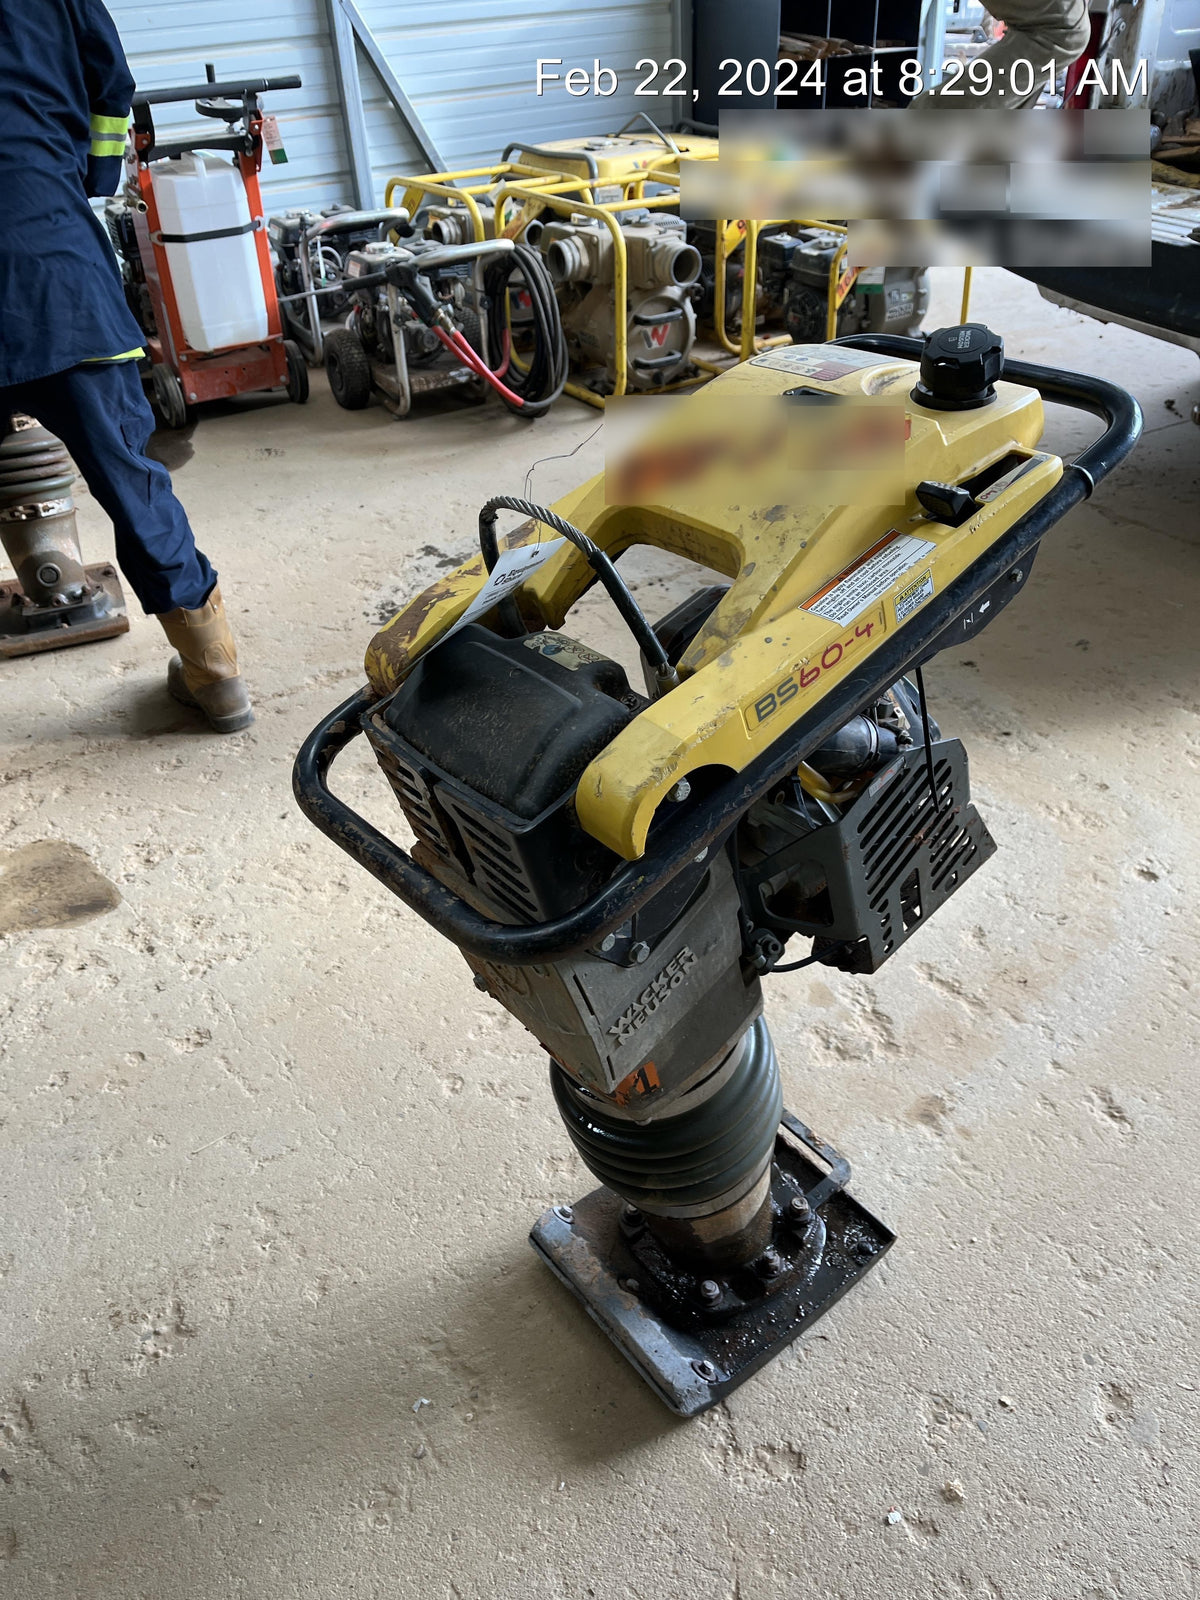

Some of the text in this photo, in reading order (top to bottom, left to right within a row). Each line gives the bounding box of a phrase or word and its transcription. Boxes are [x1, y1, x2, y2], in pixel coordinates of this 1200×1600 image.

[811, 596, 828, 610] Gasoline
[826, 594, 840, 605] engine
[869, 560, 882, 570] before
[833, 598, 847, 609] engine
[837, 611, 848, 619] Read
[847, 598, 864, 611] Owner's
[863, 587, 878, 599] Manual
[877, 577, 890, 587] before
[754, 622, 874, 723] BS60-4
[607, 945, 694, 1035] WACKER
[617, 953, 698, 1047] NEUSON
